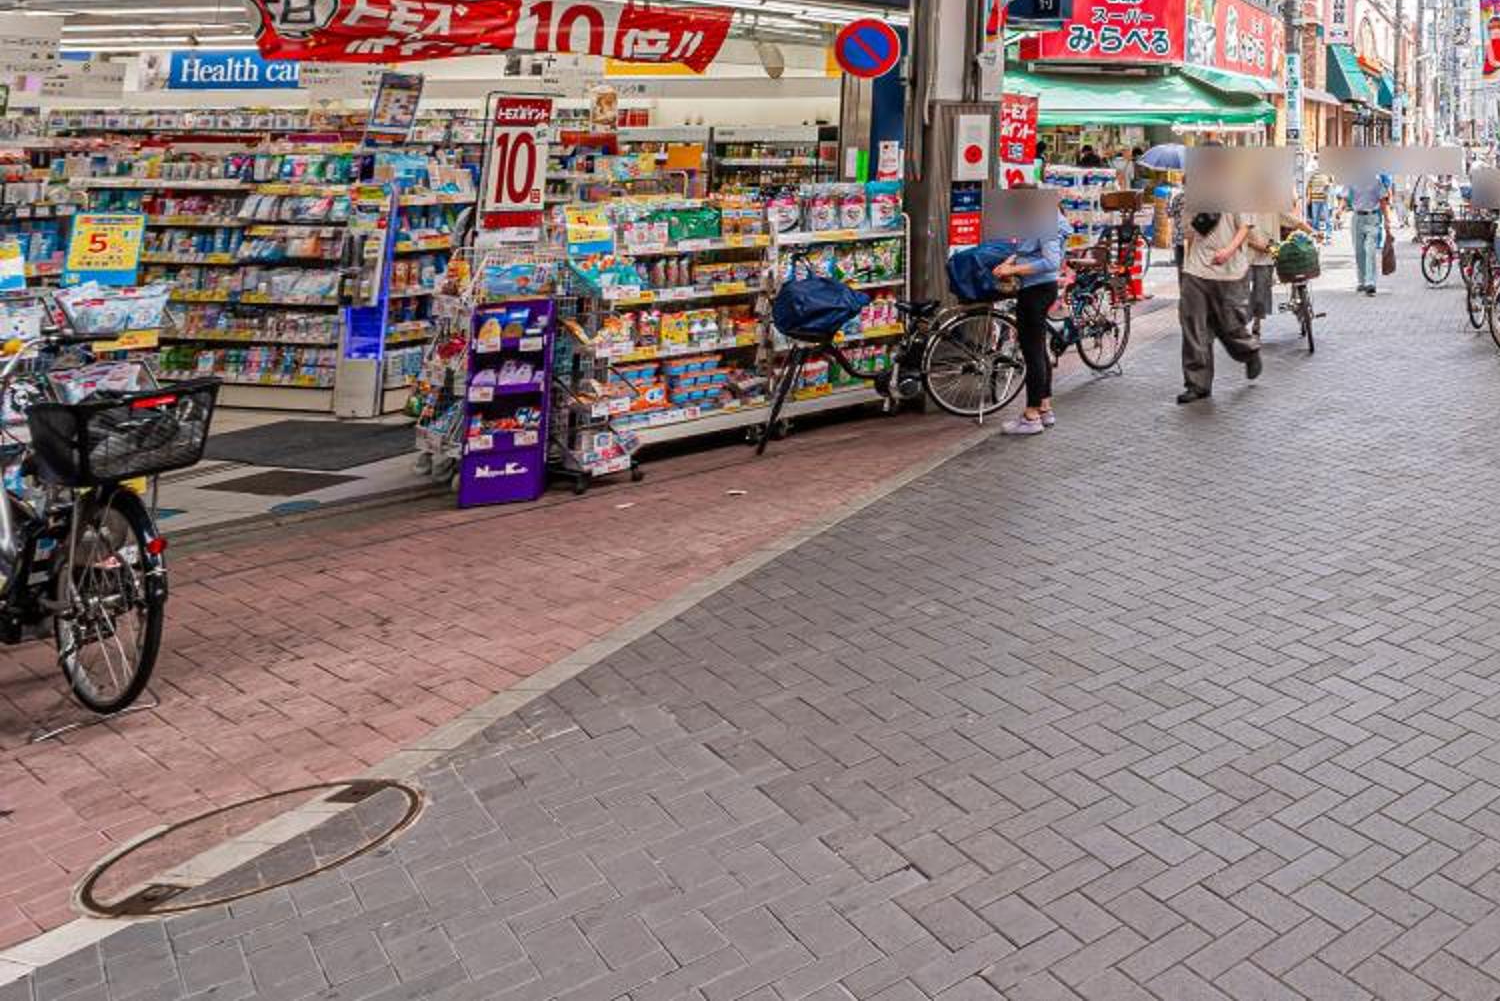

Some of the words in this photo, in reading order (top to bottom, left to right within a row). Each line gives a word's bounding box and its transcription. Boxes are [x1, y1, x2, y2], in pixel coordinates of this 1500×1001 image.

[1092, 8, 1153, 24] スーパー
[1068, 25, 1170, 56] みらべる
[180, 58, 257, 83] Health
[494, 132, 538, 204] 10
